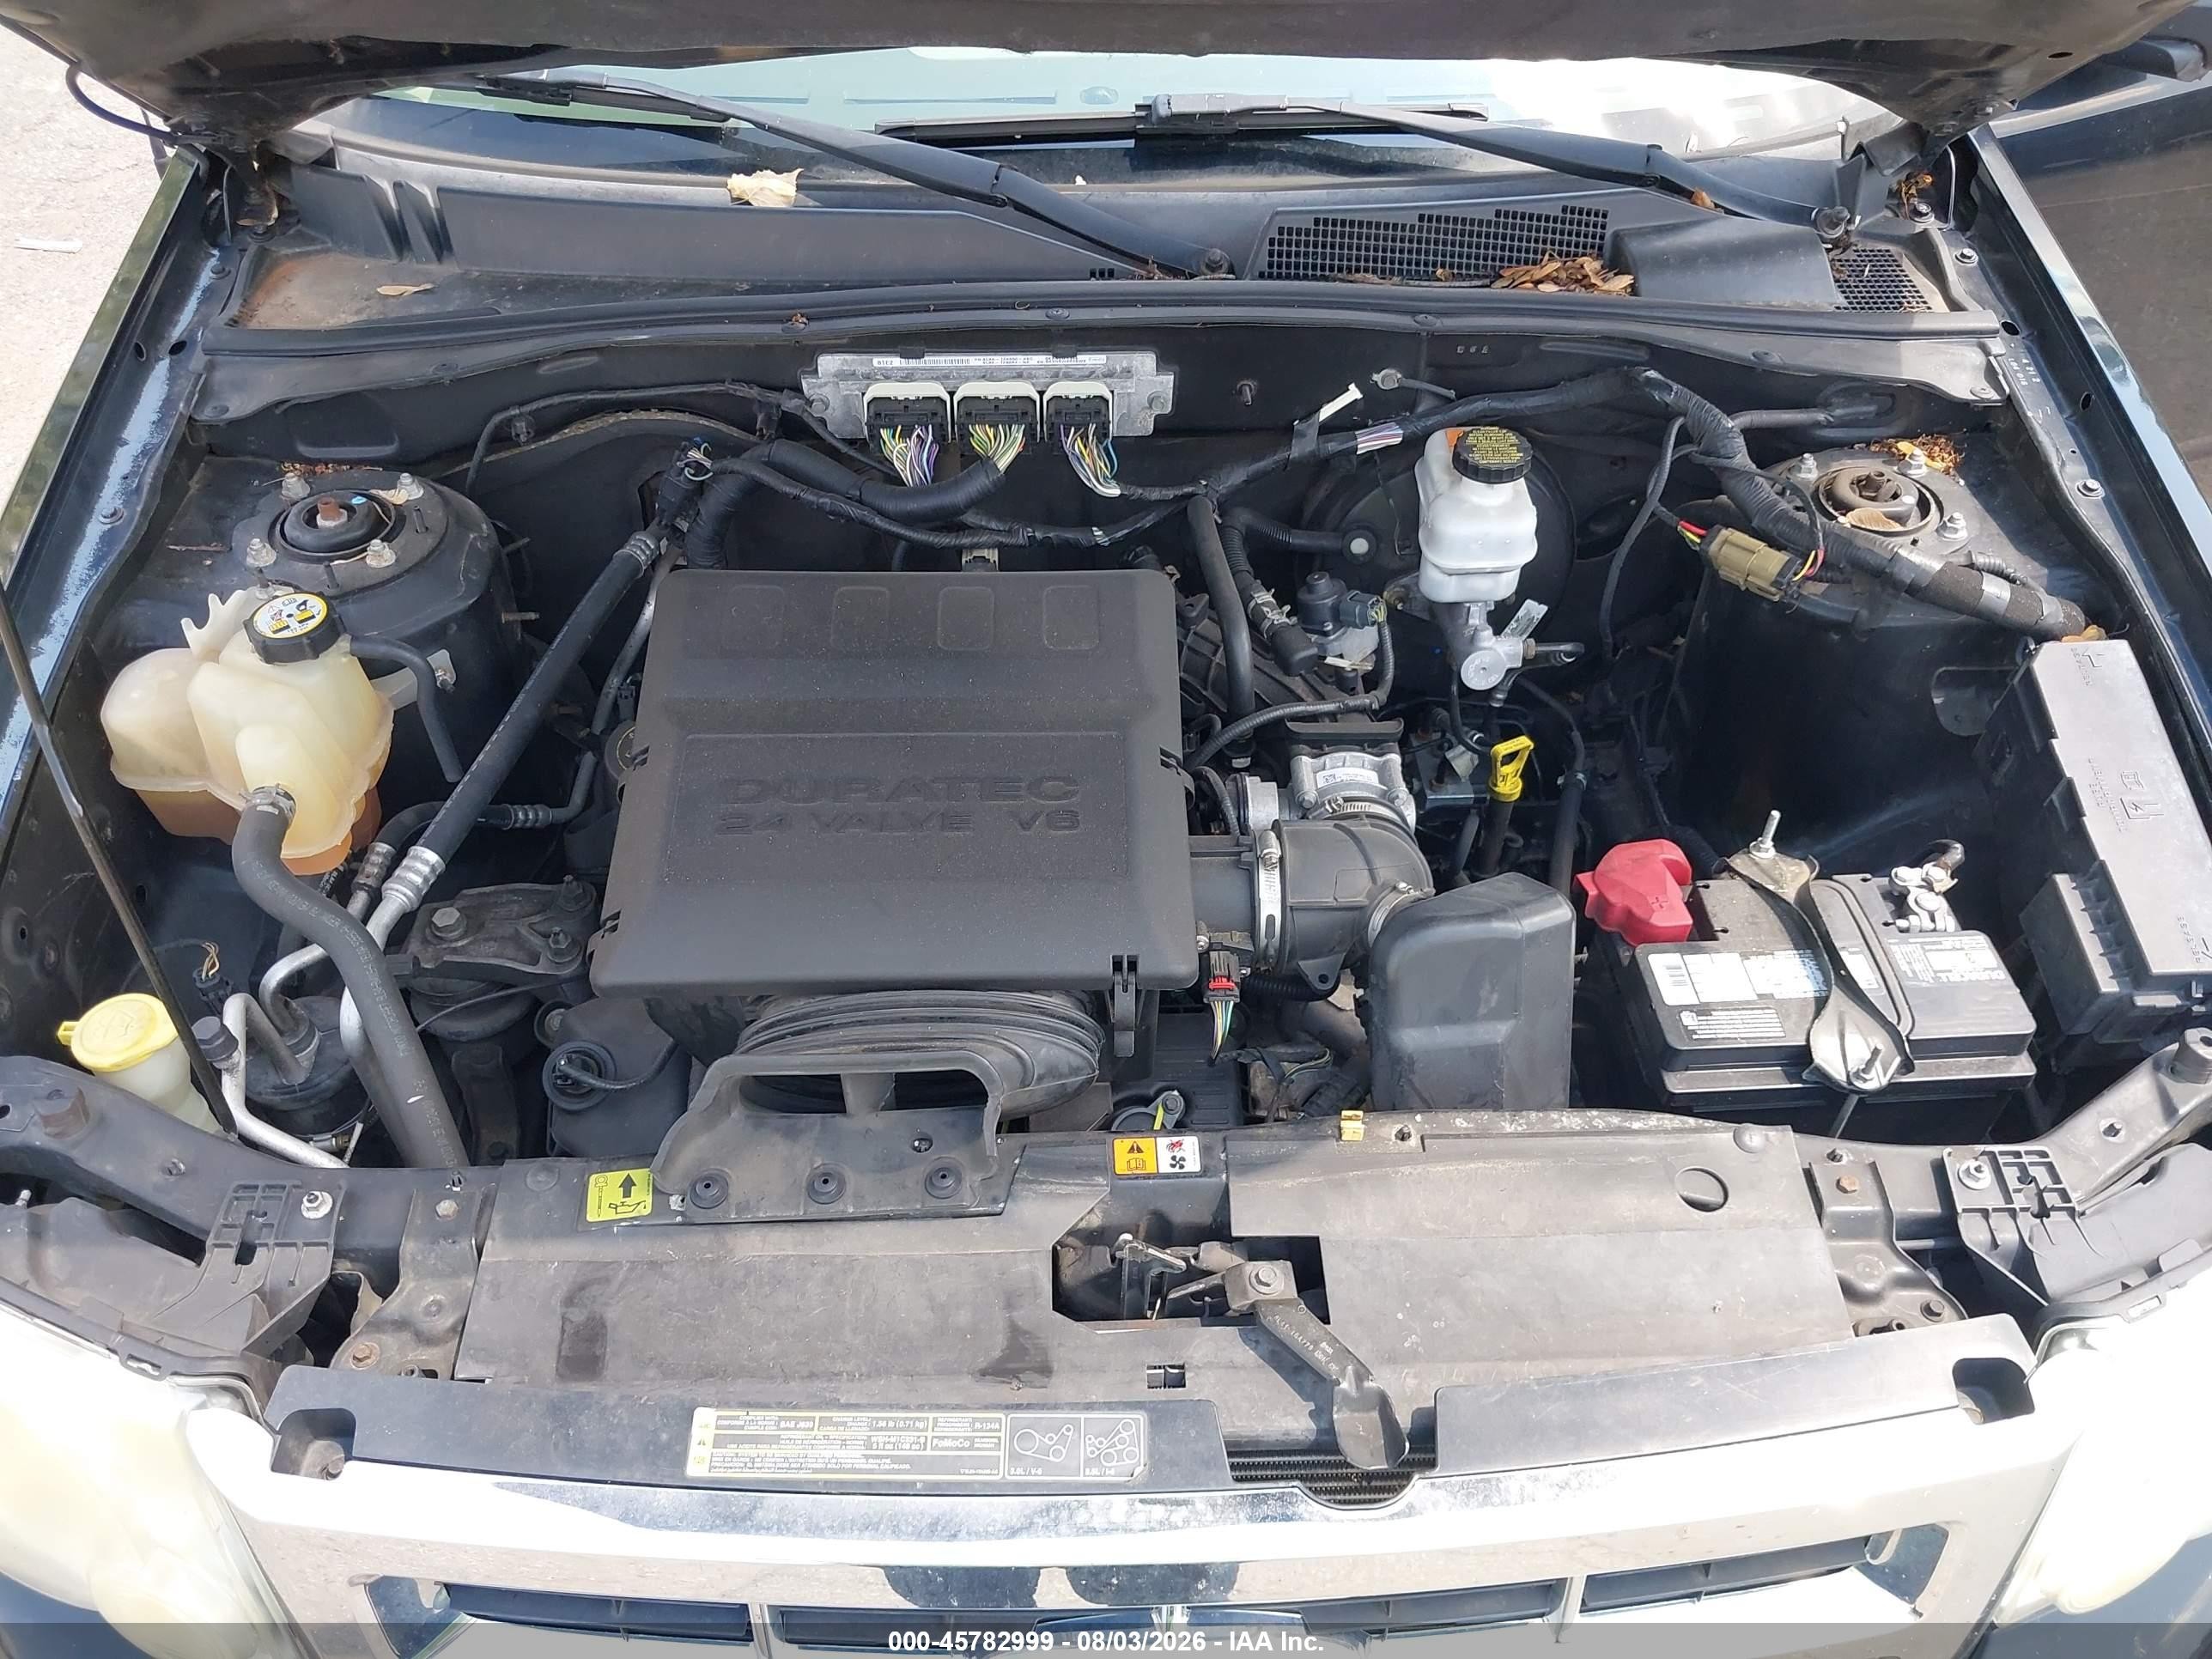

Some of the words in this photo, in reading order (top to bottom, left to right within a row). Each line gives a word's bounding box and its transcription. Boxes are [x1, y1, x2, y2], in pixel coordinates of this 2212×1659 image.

[720, 775, 1080, 805] DURATEC
[714, 814, 792, 836] 24
[808, 811, 975, 835] VALVE
[1011, 809, 1081, 833] V6
[932, 1438, 971, 1448] FoMoCo
